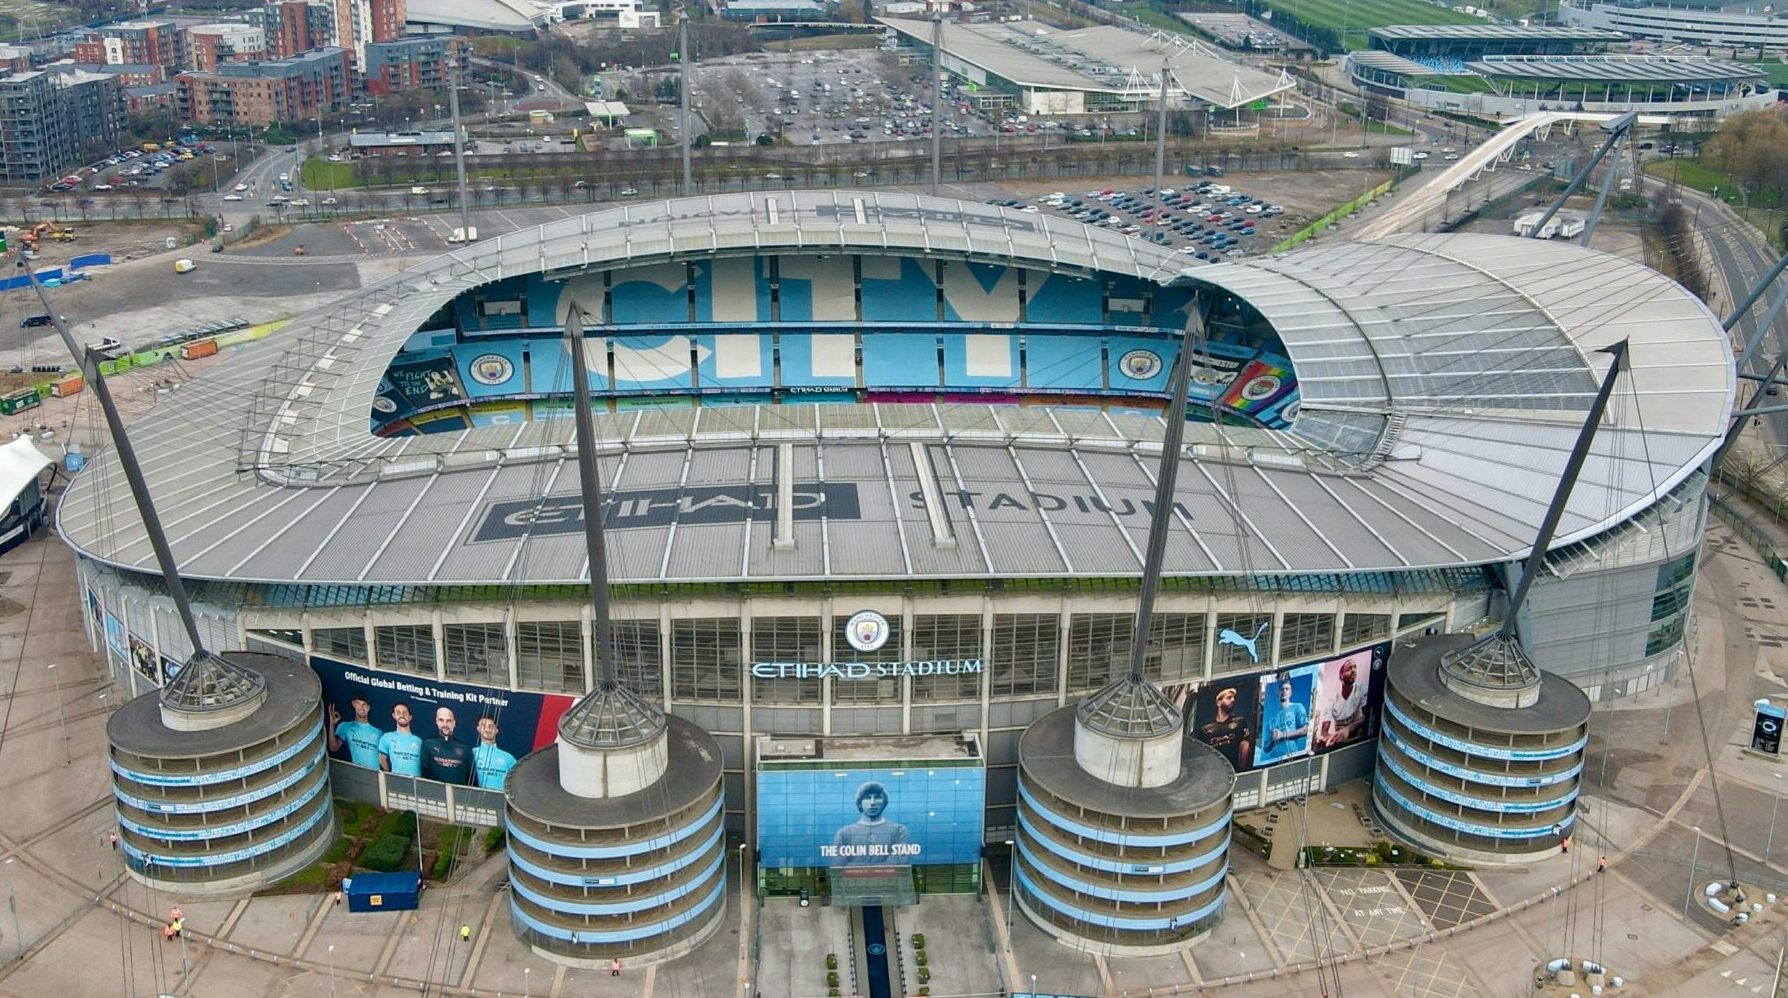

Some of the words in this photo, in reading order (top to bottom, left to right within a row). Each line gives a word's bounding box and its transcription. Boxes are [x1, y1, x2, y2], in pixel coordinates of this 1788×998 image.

[405, 384, 429, 396] END
[752, 661, 871, 679] ETIHAD
[877, 659, 982, 678] STADIUM
[344, 671, 370, 686] Official
[371, 677, 395, 690] Global
[396, 681, 424, 697] Betting
[424, 686, 431, 697] &
[431, 688, 465, 703] Training
[465, 692, 478, 704] Kit
[478, 694, 509, 708] Partner
[820, 845, 838, 857] THE
[839, 845, 867, 857] COLIN
[869, 844, 889, 856] BELL
[891, 843, 921, 856] STAND
[1340, 888, 1356, 896] NO
